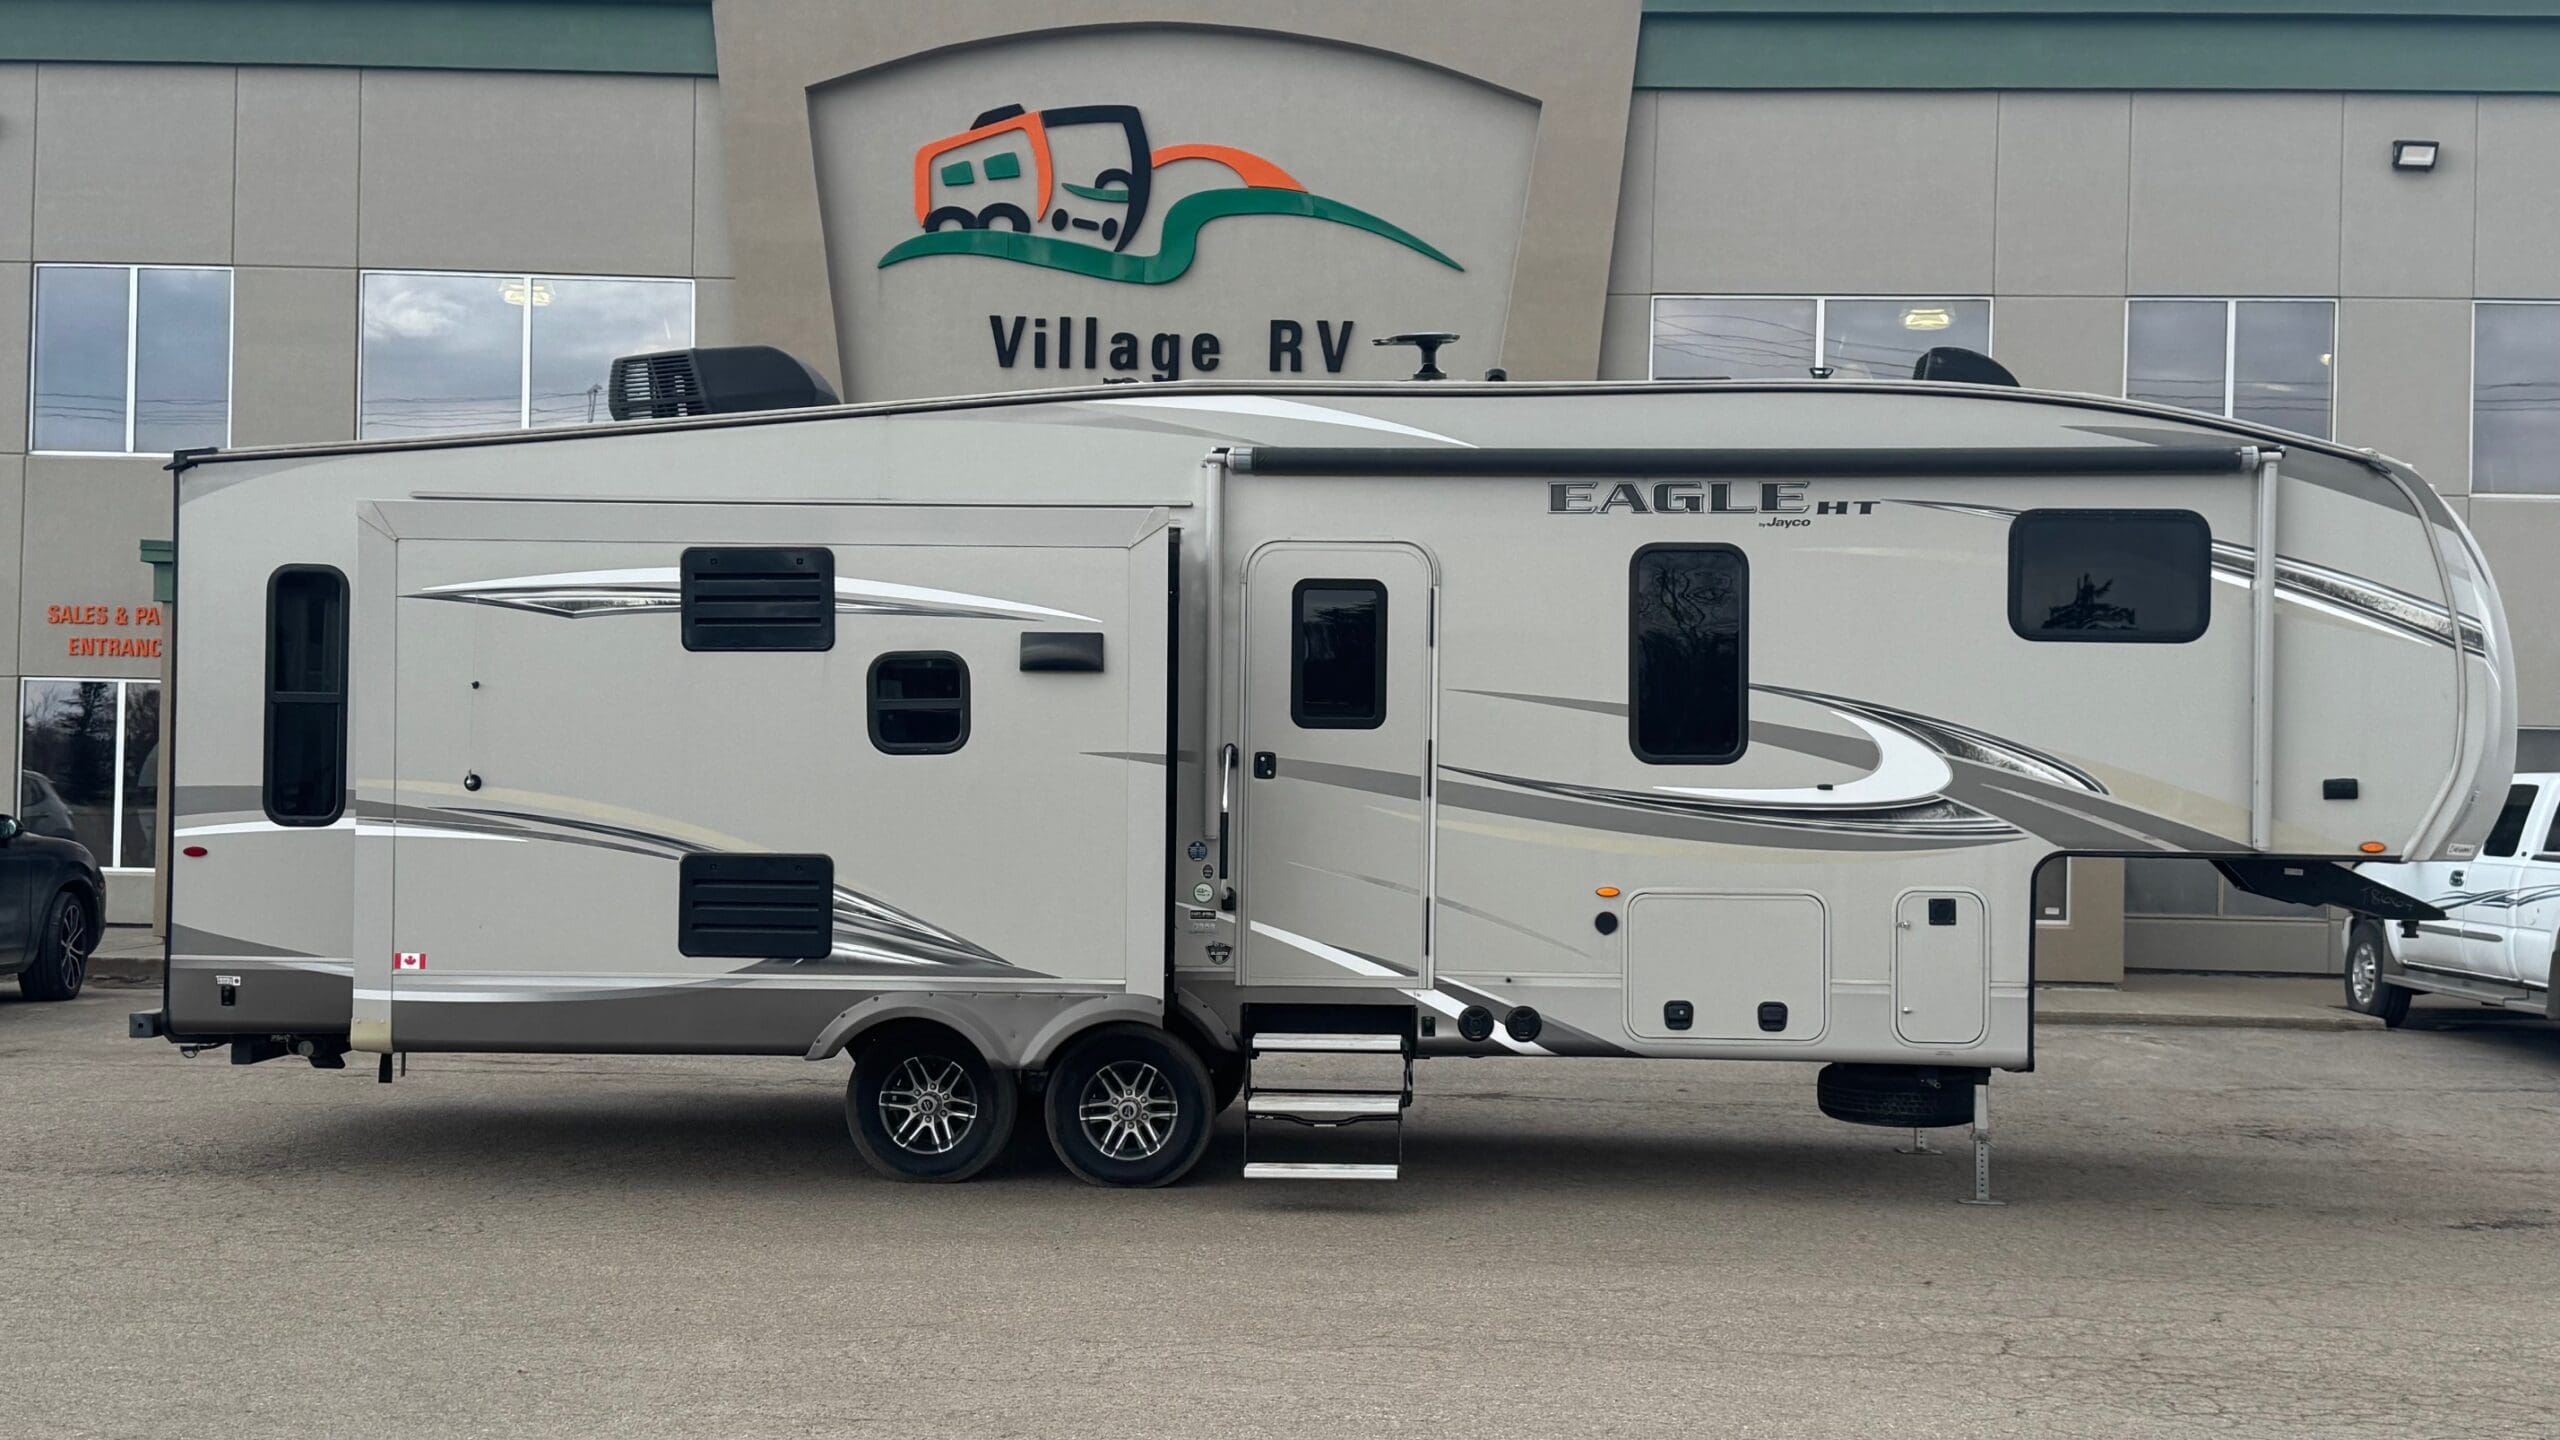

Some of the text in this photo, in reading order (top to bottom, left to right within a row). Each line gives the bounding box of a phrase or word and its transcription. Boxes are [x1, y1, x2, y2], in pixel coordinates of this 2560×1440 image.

[989, 315, 1354, 381] Village RV
[1547, 480, 1881, 515] EAGLE HT
[1766, 516, 1811, 529] Jayco
[48, 604, 162, 626] SALES & PA
[68, 637, 162, 657] ENTRANC
